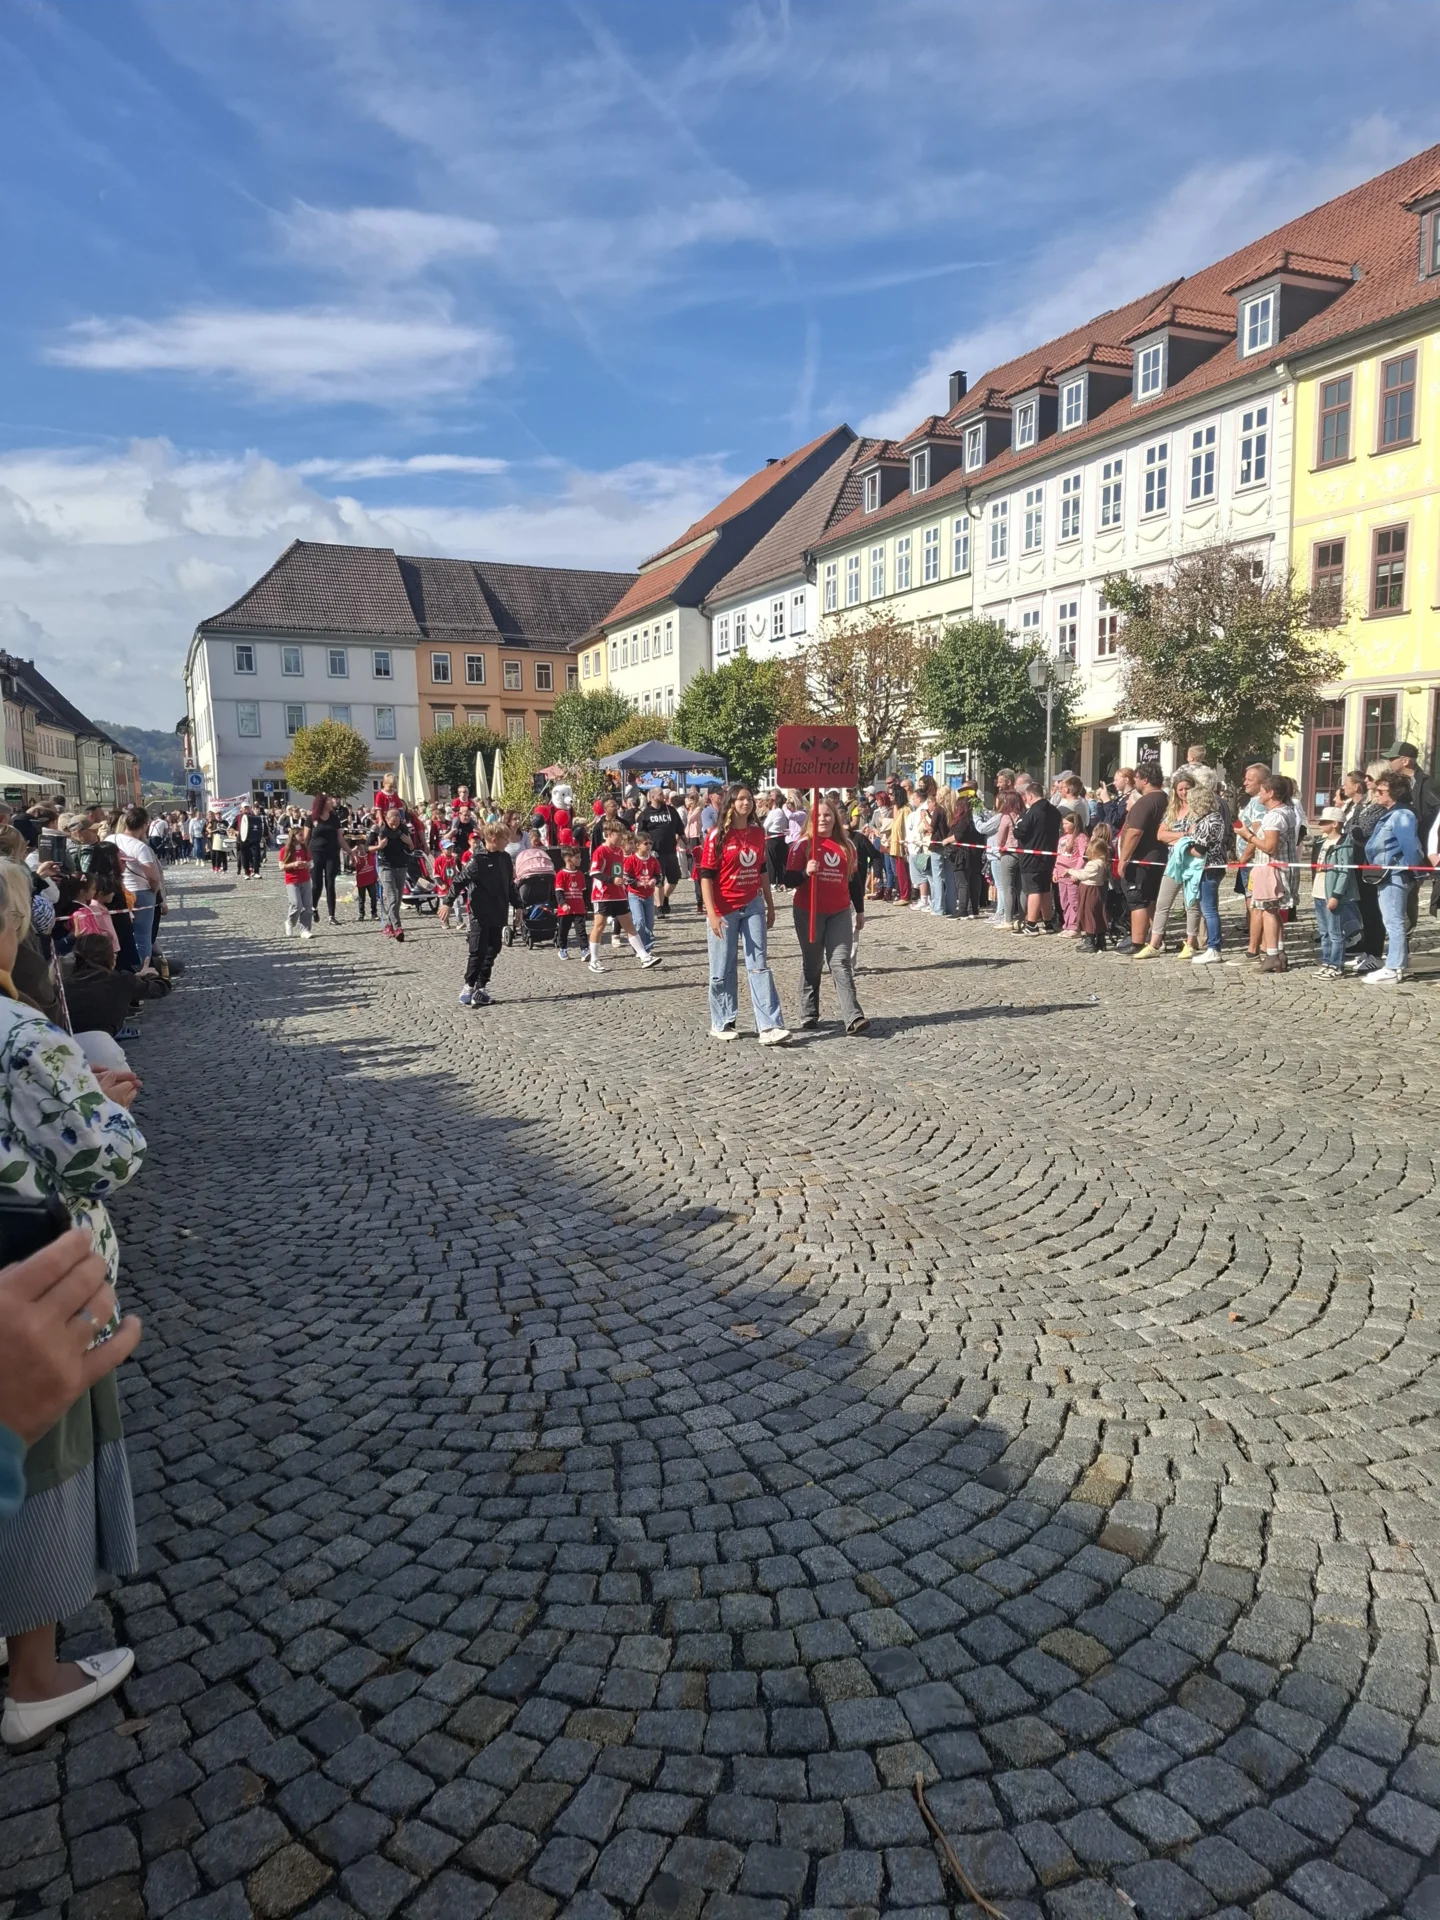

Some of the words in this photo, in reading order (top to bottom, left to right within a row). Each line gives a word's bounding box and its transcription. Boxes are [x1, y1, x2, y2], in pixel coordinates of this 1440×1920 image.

[782, 757, 855, 775] Häselrieth
[650, 814, 672, 823] COACH
[613, 864, 622, 875] D
